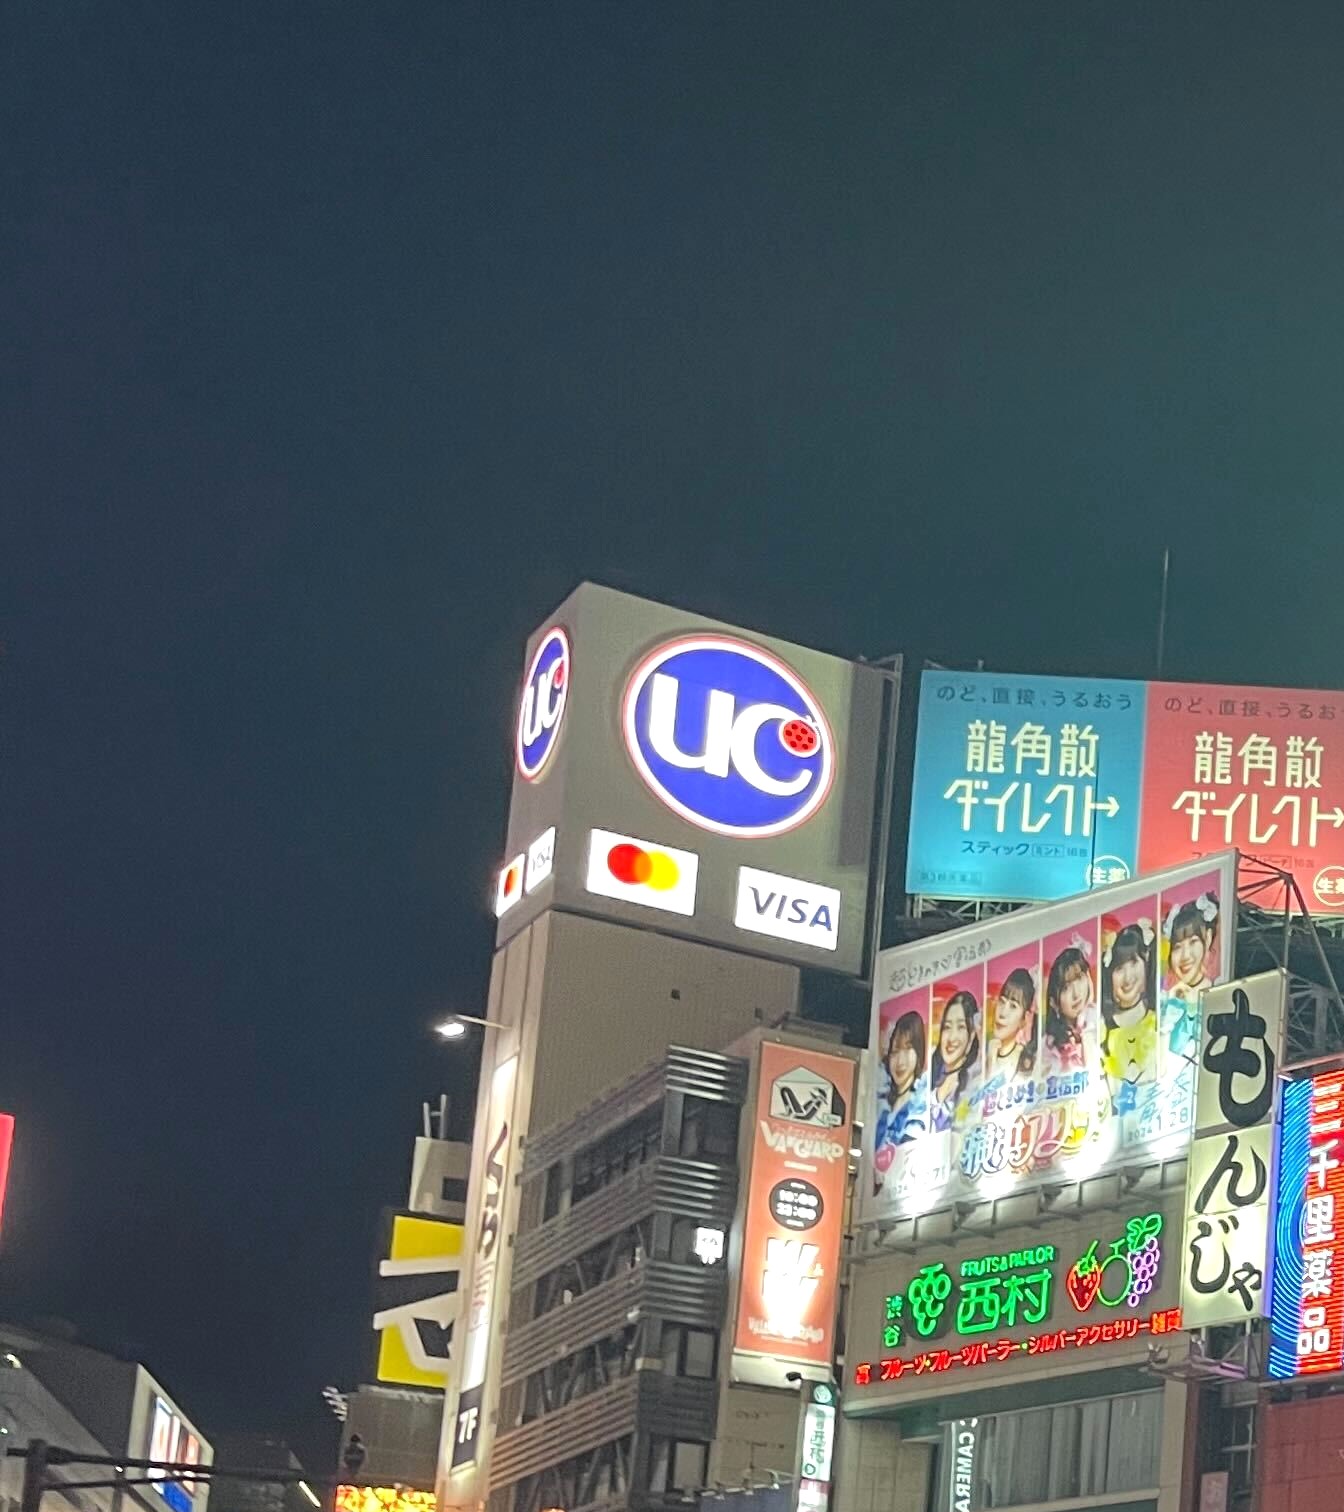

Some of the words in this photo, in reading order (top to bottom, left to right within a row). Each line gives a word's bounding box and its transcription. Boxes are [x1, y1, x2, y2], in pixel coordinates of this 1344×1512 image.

[647, 672, 824, 797] UC
[966, 719, 1099, 777] 龍角散
[1194, 731, 1324, 789] 龍角散
[749, 886, 833, 932] VISA
[1190, 988, 1275, 1312] もんじゃ
[1296, 1082, 1344, 1355] 三千里薬品
[957, 1269, 1053, 1335] 西村
